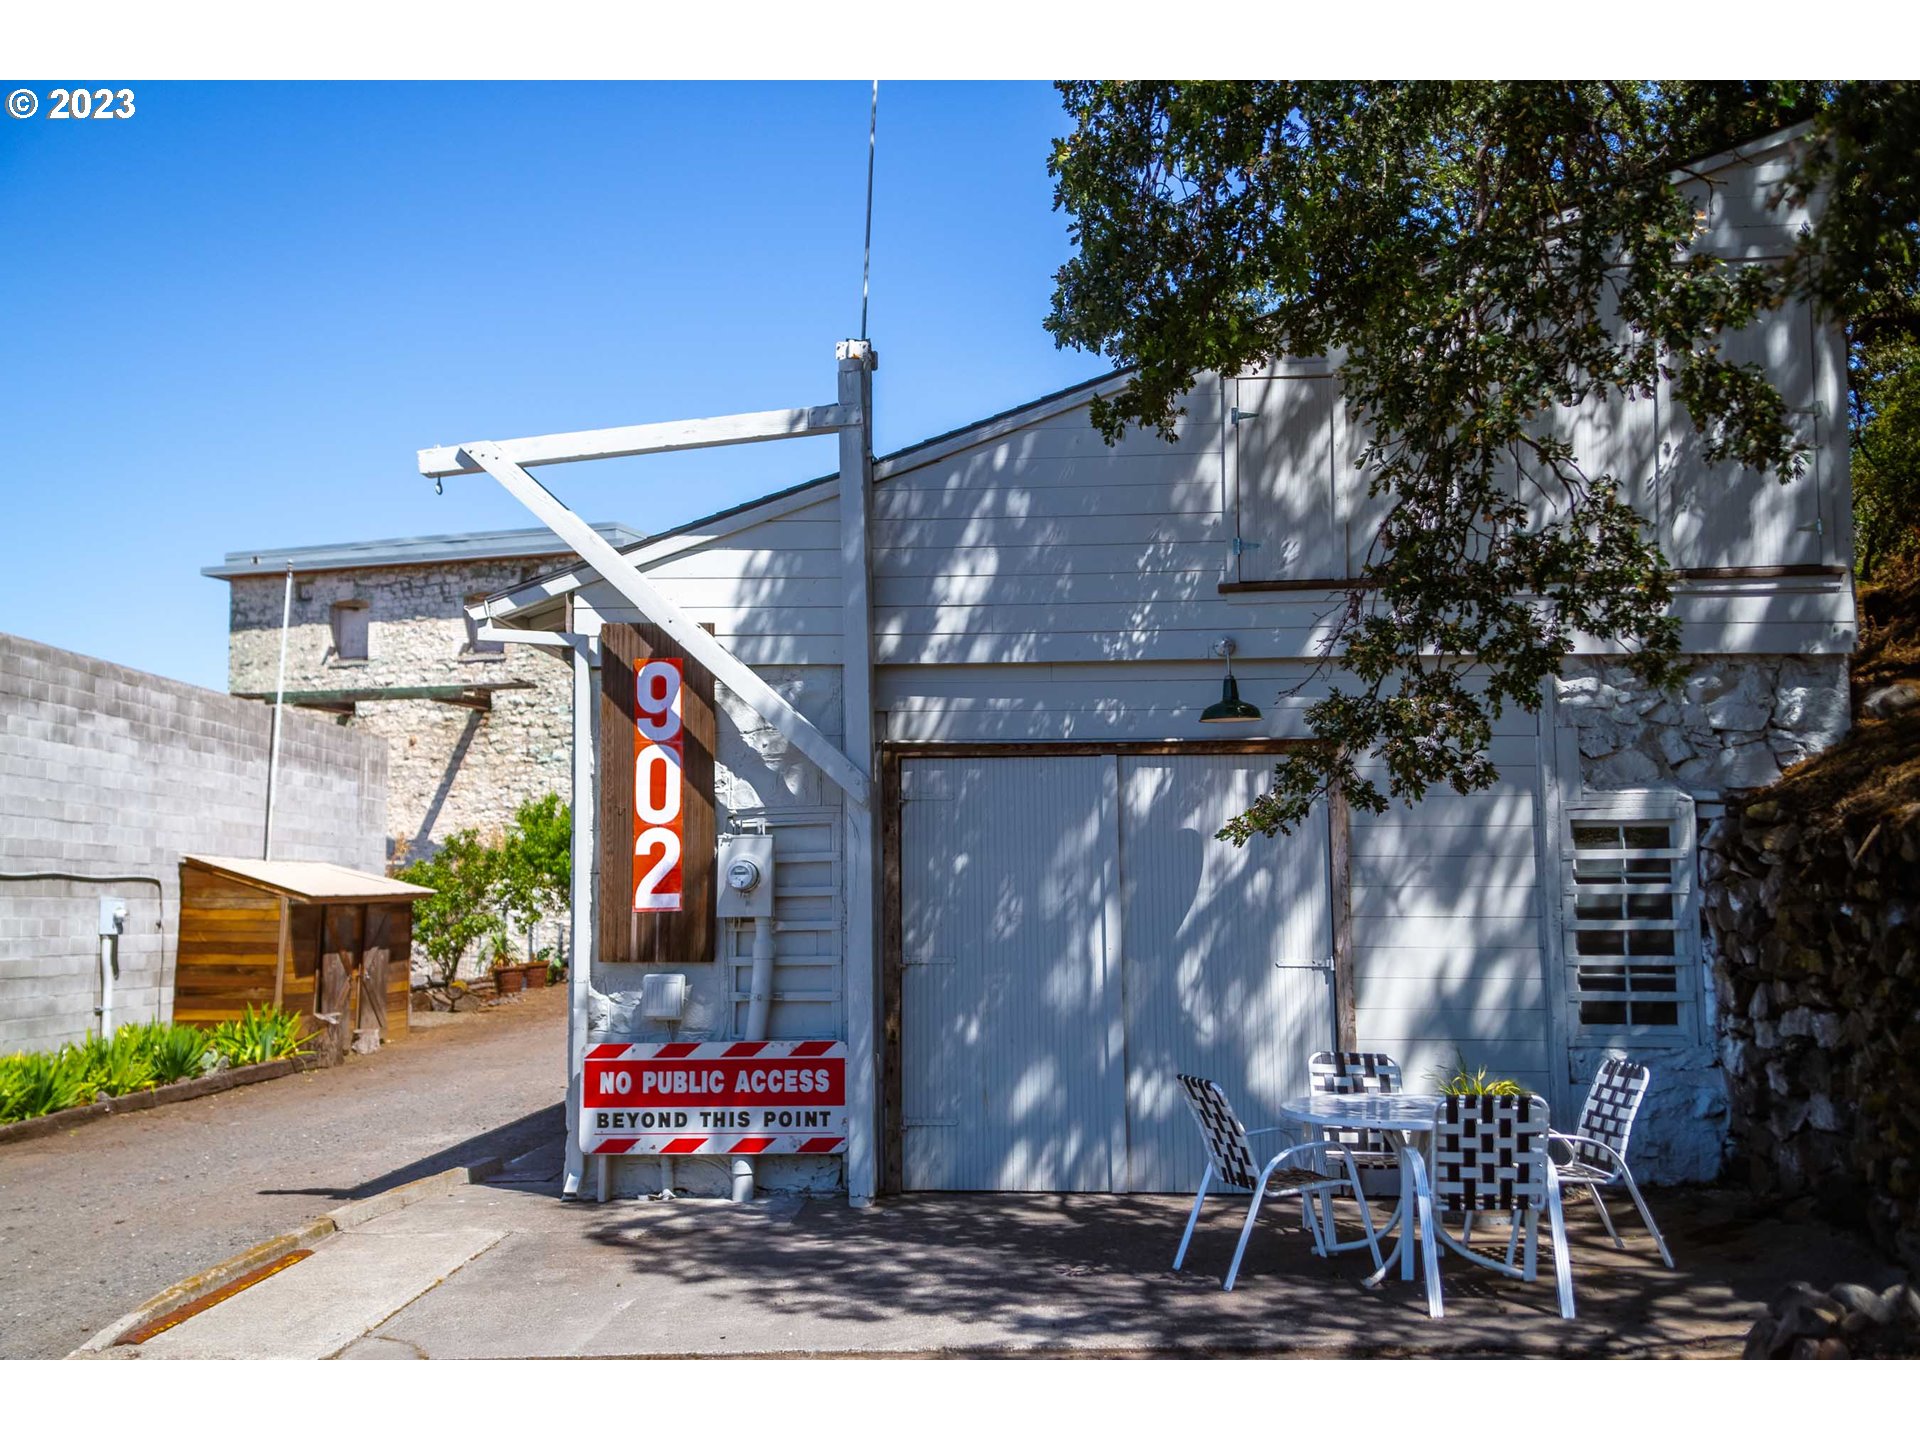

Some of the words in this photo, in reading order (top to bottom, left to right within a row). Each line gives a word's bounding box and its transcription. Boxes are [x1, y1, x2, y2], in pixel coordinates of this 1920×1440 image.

[635, 661, 681, 909] 902
[599, 1071, 632, 1094] NO
[642, 1070, 725, 1094] PUBLIC
[735, 1069, 830, 1093] ACCESS
[597, 1112, 688, 1128] BEYOND
[699, 1111, 751, 1128] THIS
[763, 1111, 831, 1127] POINT
